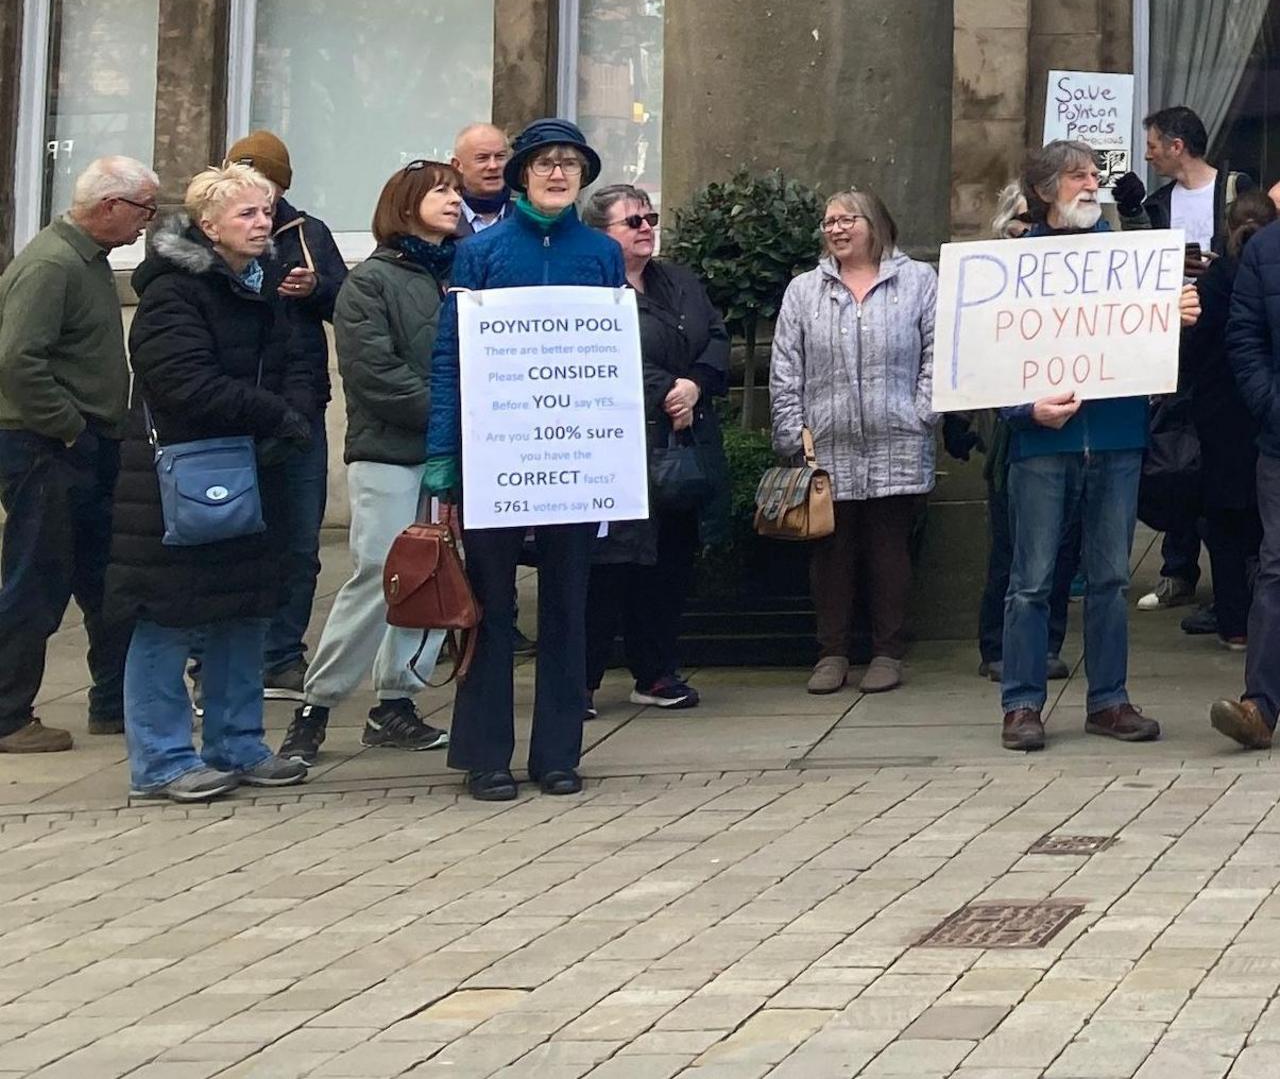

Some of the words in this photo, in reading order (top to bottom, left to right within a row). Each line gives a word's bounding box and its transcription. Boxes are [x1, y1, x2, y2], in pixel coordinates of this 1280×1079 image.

[1056, 77, 1116, 102] Save
[1057, 103, 1117, 122] Poynton
[480, 318, 569, 335] POYNTON
[575, 318, 623, 332] POOL
[952, 248, 1181, 389] PRESERVE
[996, 302, 1171, 342] POYNTON
[484, 345, 518, 357] There
[520, 346, 538, 356] are
[541, 344, 574, 355] better
[488, 372, 525, 383] Please
[528, 365, 619, 381] CONSIDER
[1023, 354, 1115, 389] POOL
[492, 400, 529, 411] Before
[532, 394, 571, 409] YOU
[574, 400, 592, 410] say
[486, 432, 506, 442] Are
[508, 433, 530, 443] you
[533, 425, 581, 441] 100%
[587, 426, 624, 439] sure
[520, 452, 541, 463] you
[544, 450, 570, 461] have
[573, 449, 592, 460] the
[496, 471, 581, 487] CORRECT
[583, 474, 616, 485] facts?
[493, 500, 530, 513] 5761
[533, 501, 568, 512] voters
[570, 501, 589, 512] say
[592, 497, 615, 510] NO
